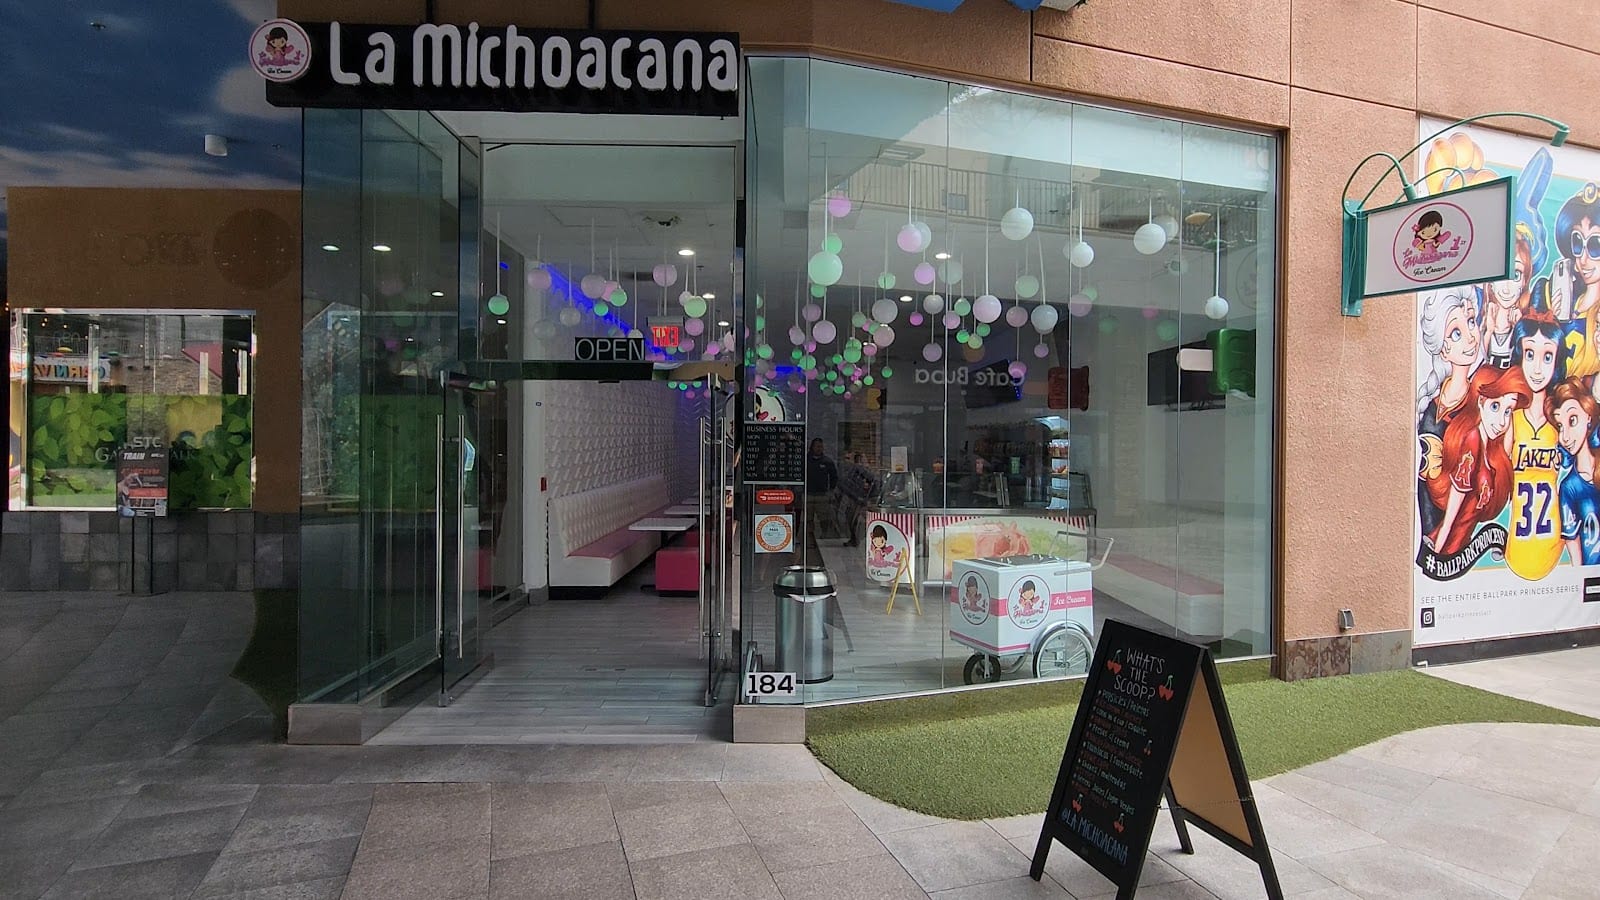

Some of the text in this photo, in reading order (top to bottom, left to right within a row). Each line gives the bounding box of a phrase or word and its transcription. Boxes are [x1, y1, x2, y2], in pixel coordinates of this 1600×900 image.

[329, 20, 738, 92] La Michoacana
[575, 338, 645, 361] OPEN
[746, 425, 777, 433] BUSINESS
[1514, 444, 1561, 472] LAKERS
[1515, 481, 1553, 538] 32
[1425, 527, 1506, 577] #BALLPARKPRINCESS
[1421, 596, 1435, 605] SEE
[1438, 594, 1452, 603] THE
[1455, 592, 1481, 602] ENTIRE
[1483, 589, 1518, 600] BALLPARK
[1520, 587, 1554, 597] PRINCESS
[1555, 585, 1579, 594] SERIES
[1126, 648, 1165, 674] WHAT'S
[748, 674, 794, 694] 184
[1130, 666, 1148, 685] THE
[1113, 674, 1156, 704] SCOOP?
